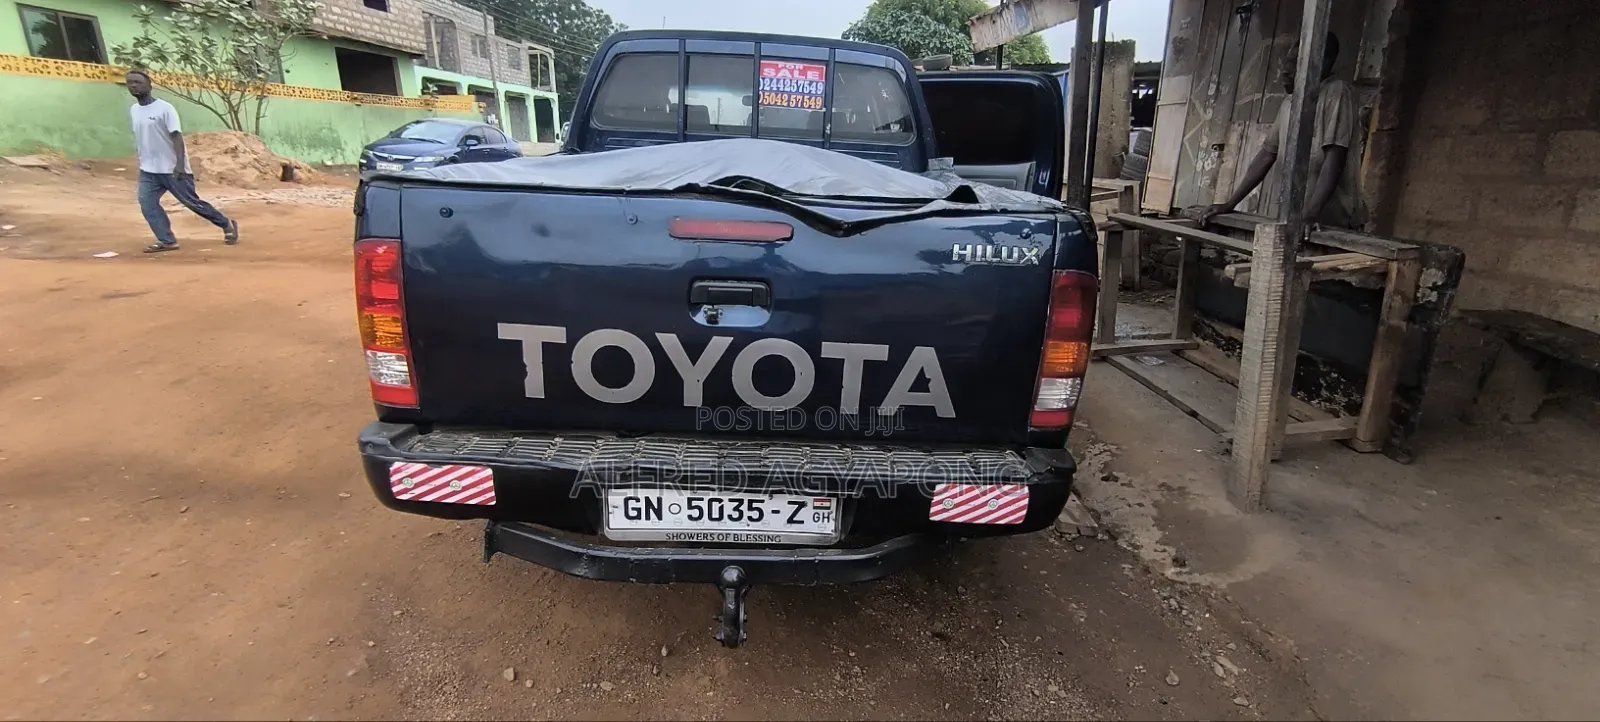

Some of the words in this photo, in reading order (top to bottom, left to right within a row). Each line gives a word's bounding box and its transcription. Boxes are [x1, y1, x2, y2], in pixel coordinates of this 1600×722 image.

[762, 67, 820, 80] SALE
[952, 243, 1039, 265] HILUX
[497, 322, 956, 418] TOYOTA
[623, 496, 663, 521] GN
[812, 510, 831, 524] GH
[665, 532, 715, 542] SHOWERS
[716, 532, 731, 542] OF
[732, 533, 782, 543] BLESSING
